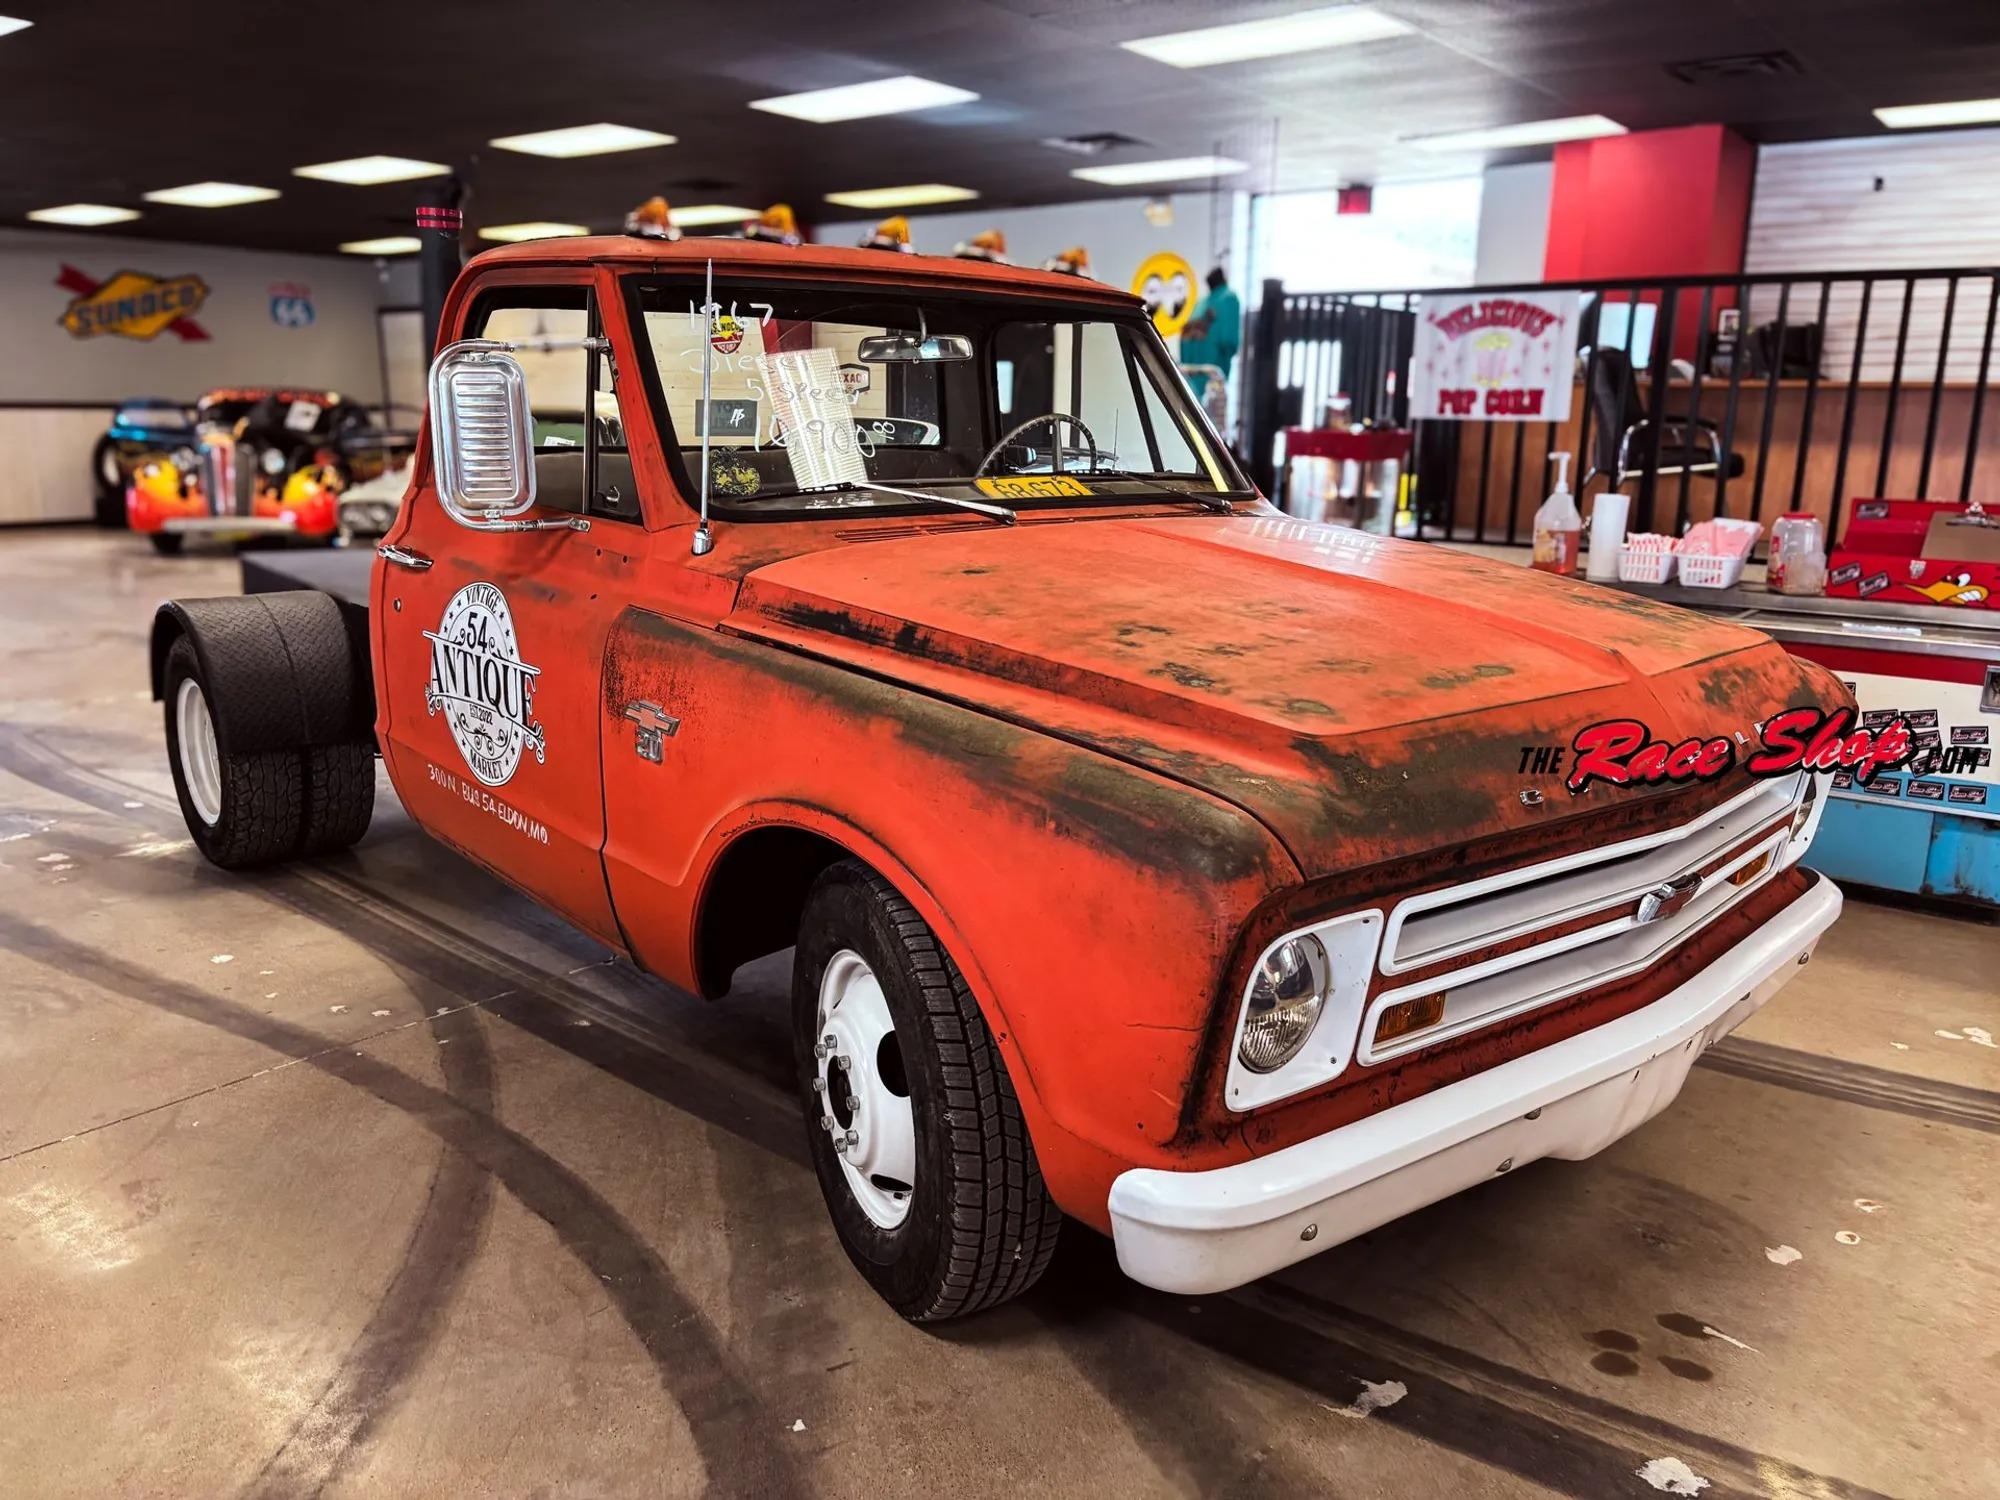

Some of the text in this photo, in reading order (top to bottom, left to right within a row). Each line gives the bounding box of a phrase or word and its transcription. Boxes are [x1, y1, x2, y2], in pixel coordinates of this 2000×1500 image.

[77, 284, 197, 330] SUNOCO
[690, 300, 774, 329] 1967
[1435, 299, 1557, 340] DELICIOUS
[746, 378, 763, 401] 5
[1438, 389, 1544, 415] POP CORN
[466, 585, 501, 613] VINTAGE
[467, 611, 488, 654] 54
[432, 641, 536, 725] ANTIQUE
[427, 764, 447, 788] 300
[469, 749, 504, 779] MARKET
